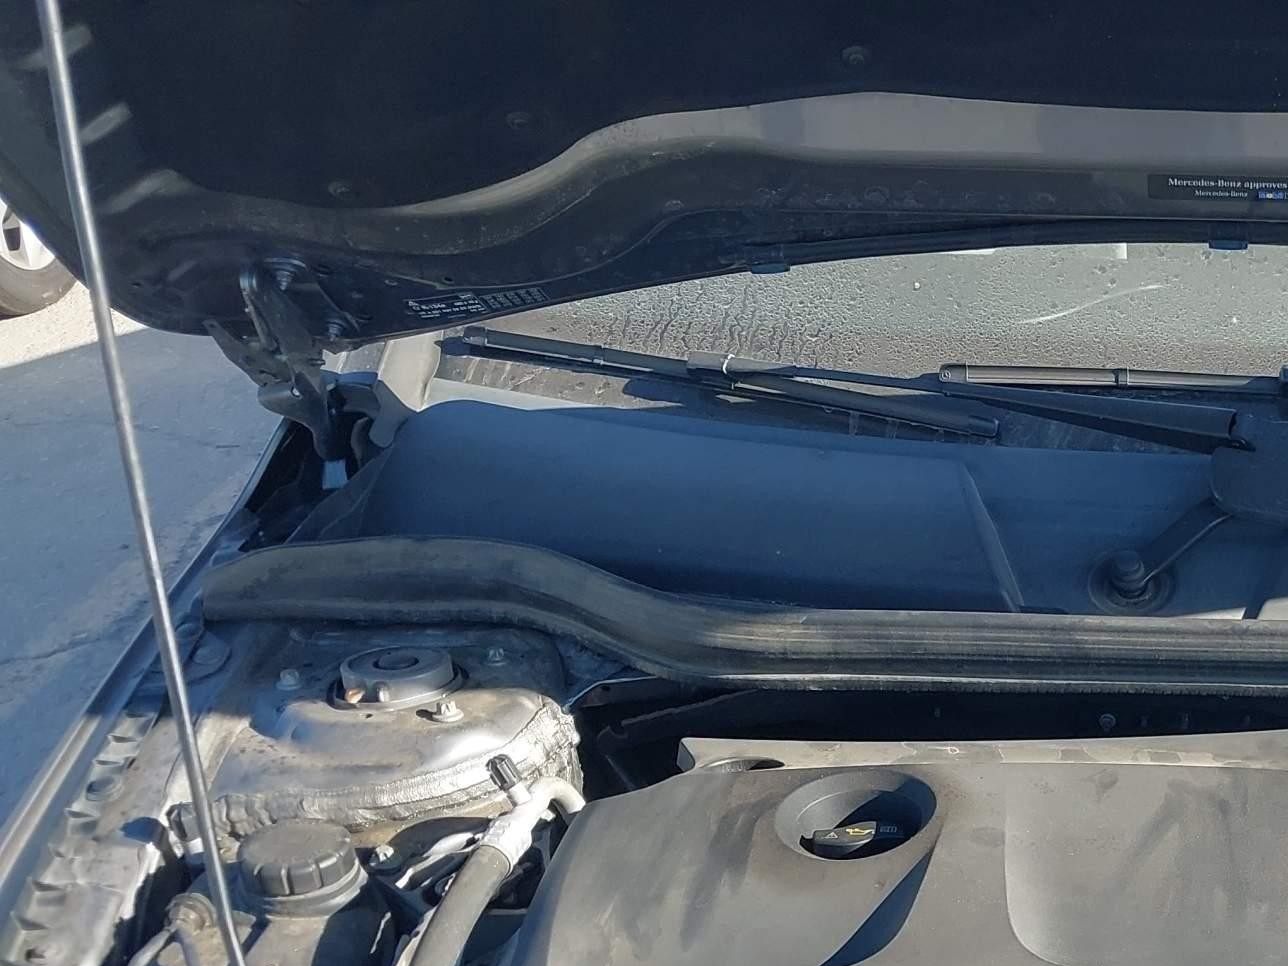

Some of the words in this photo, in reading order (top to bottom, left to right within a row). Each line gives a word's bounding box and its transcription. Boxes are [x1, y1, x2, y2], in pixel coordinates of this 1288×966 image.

[1168, 178, 1242, 188] Mercedes-Benz
[1243, 181, 1288, 190] approves
[1194, 189, 1248, 198] Mercedes-Benz
